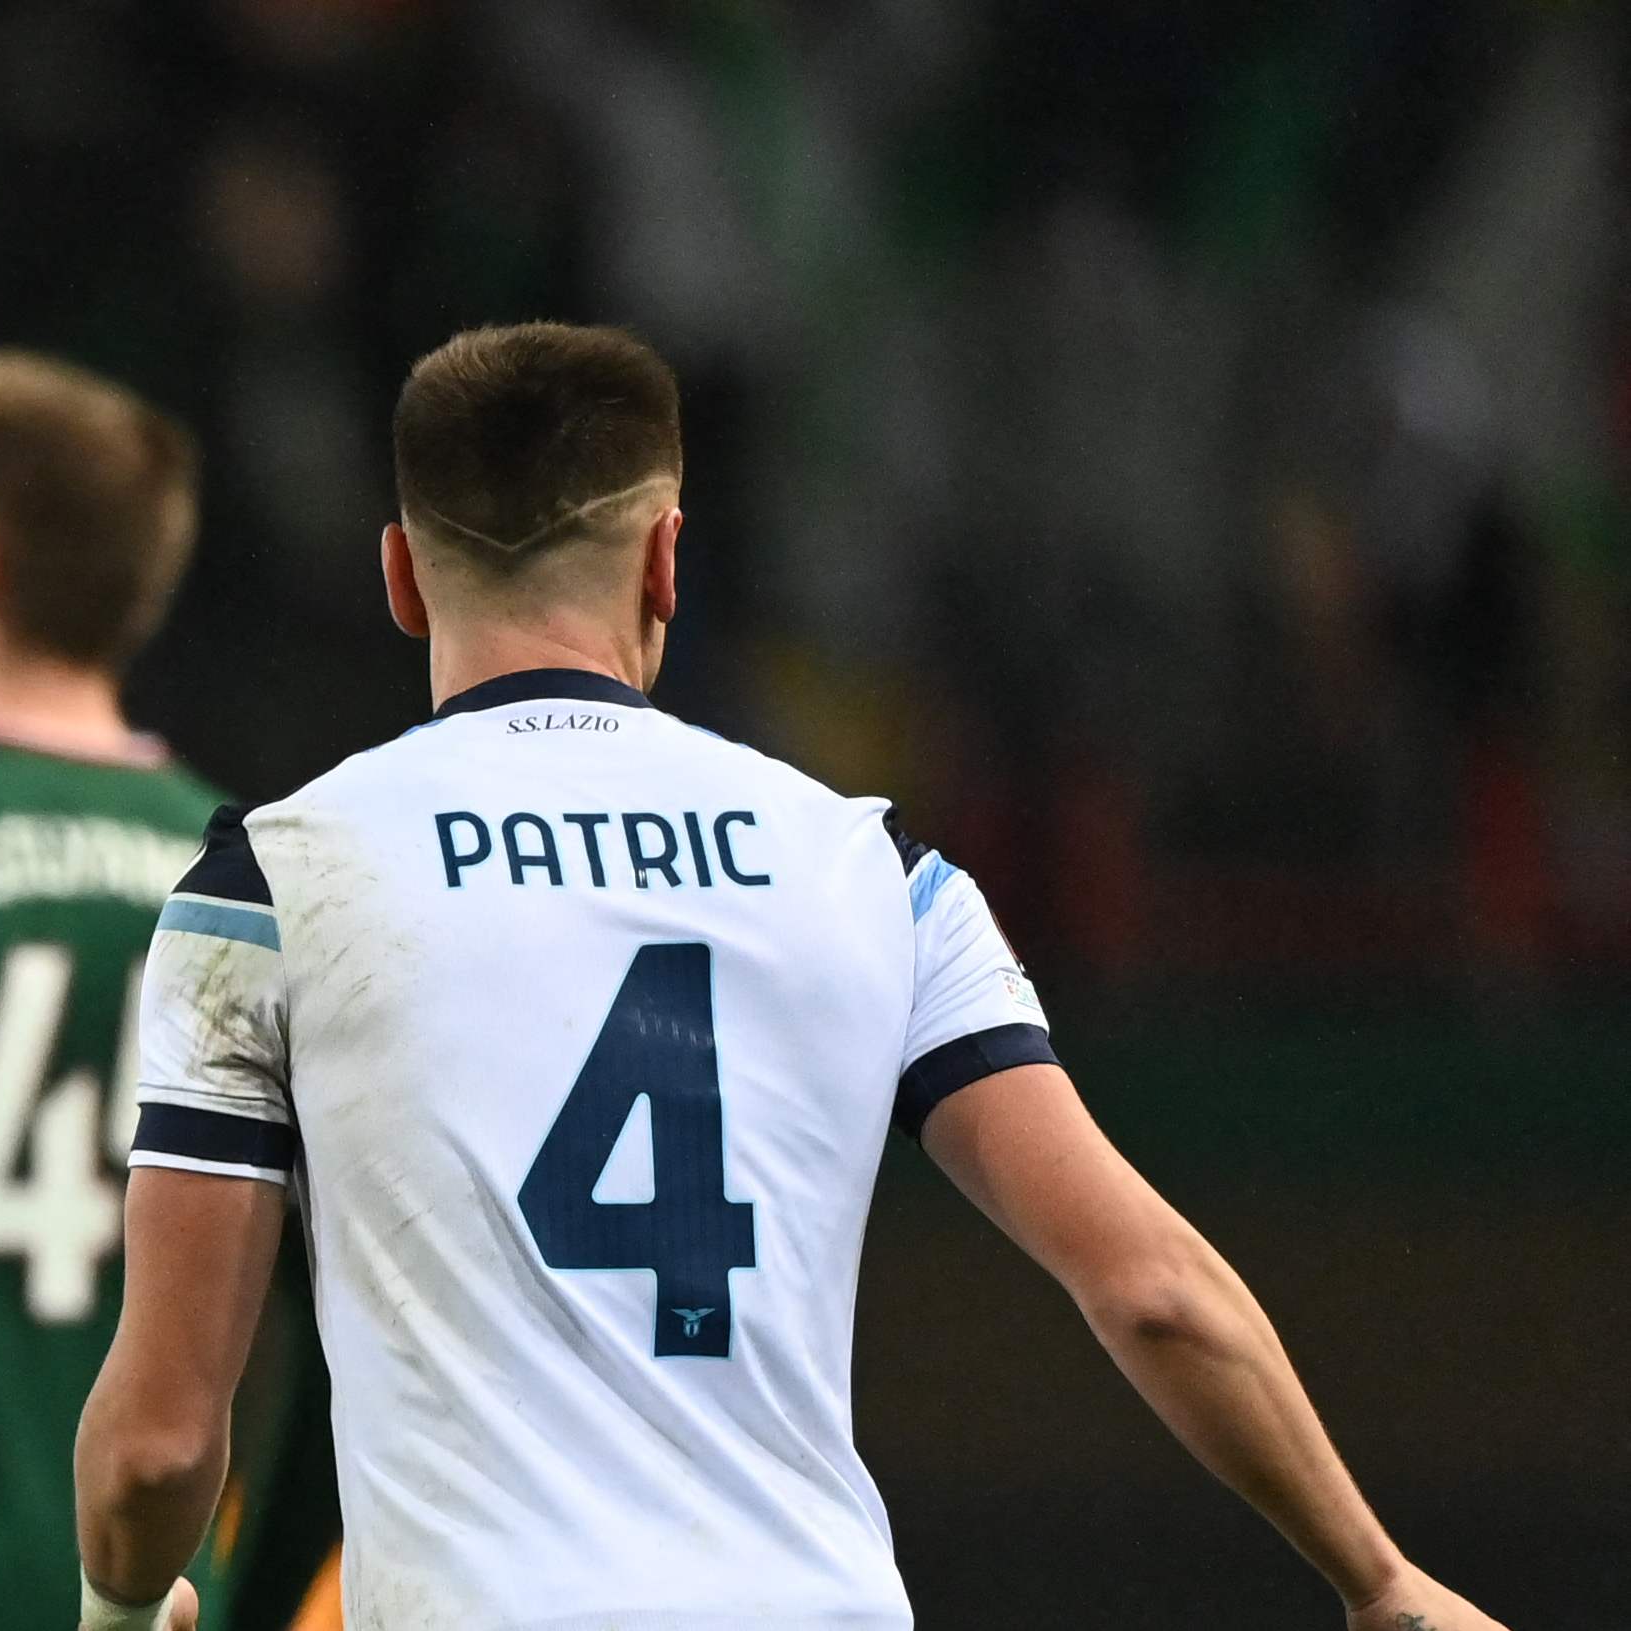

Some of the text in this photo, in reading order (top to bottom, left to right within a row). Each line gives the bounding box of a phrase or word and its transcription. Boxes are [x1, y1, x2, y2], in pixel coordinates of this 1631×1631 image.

[506, 715, 619, 734] S.S.LAZIO
[434, 811, 772, 888] PATRIC
[517, 940, 760, 1360] 4
